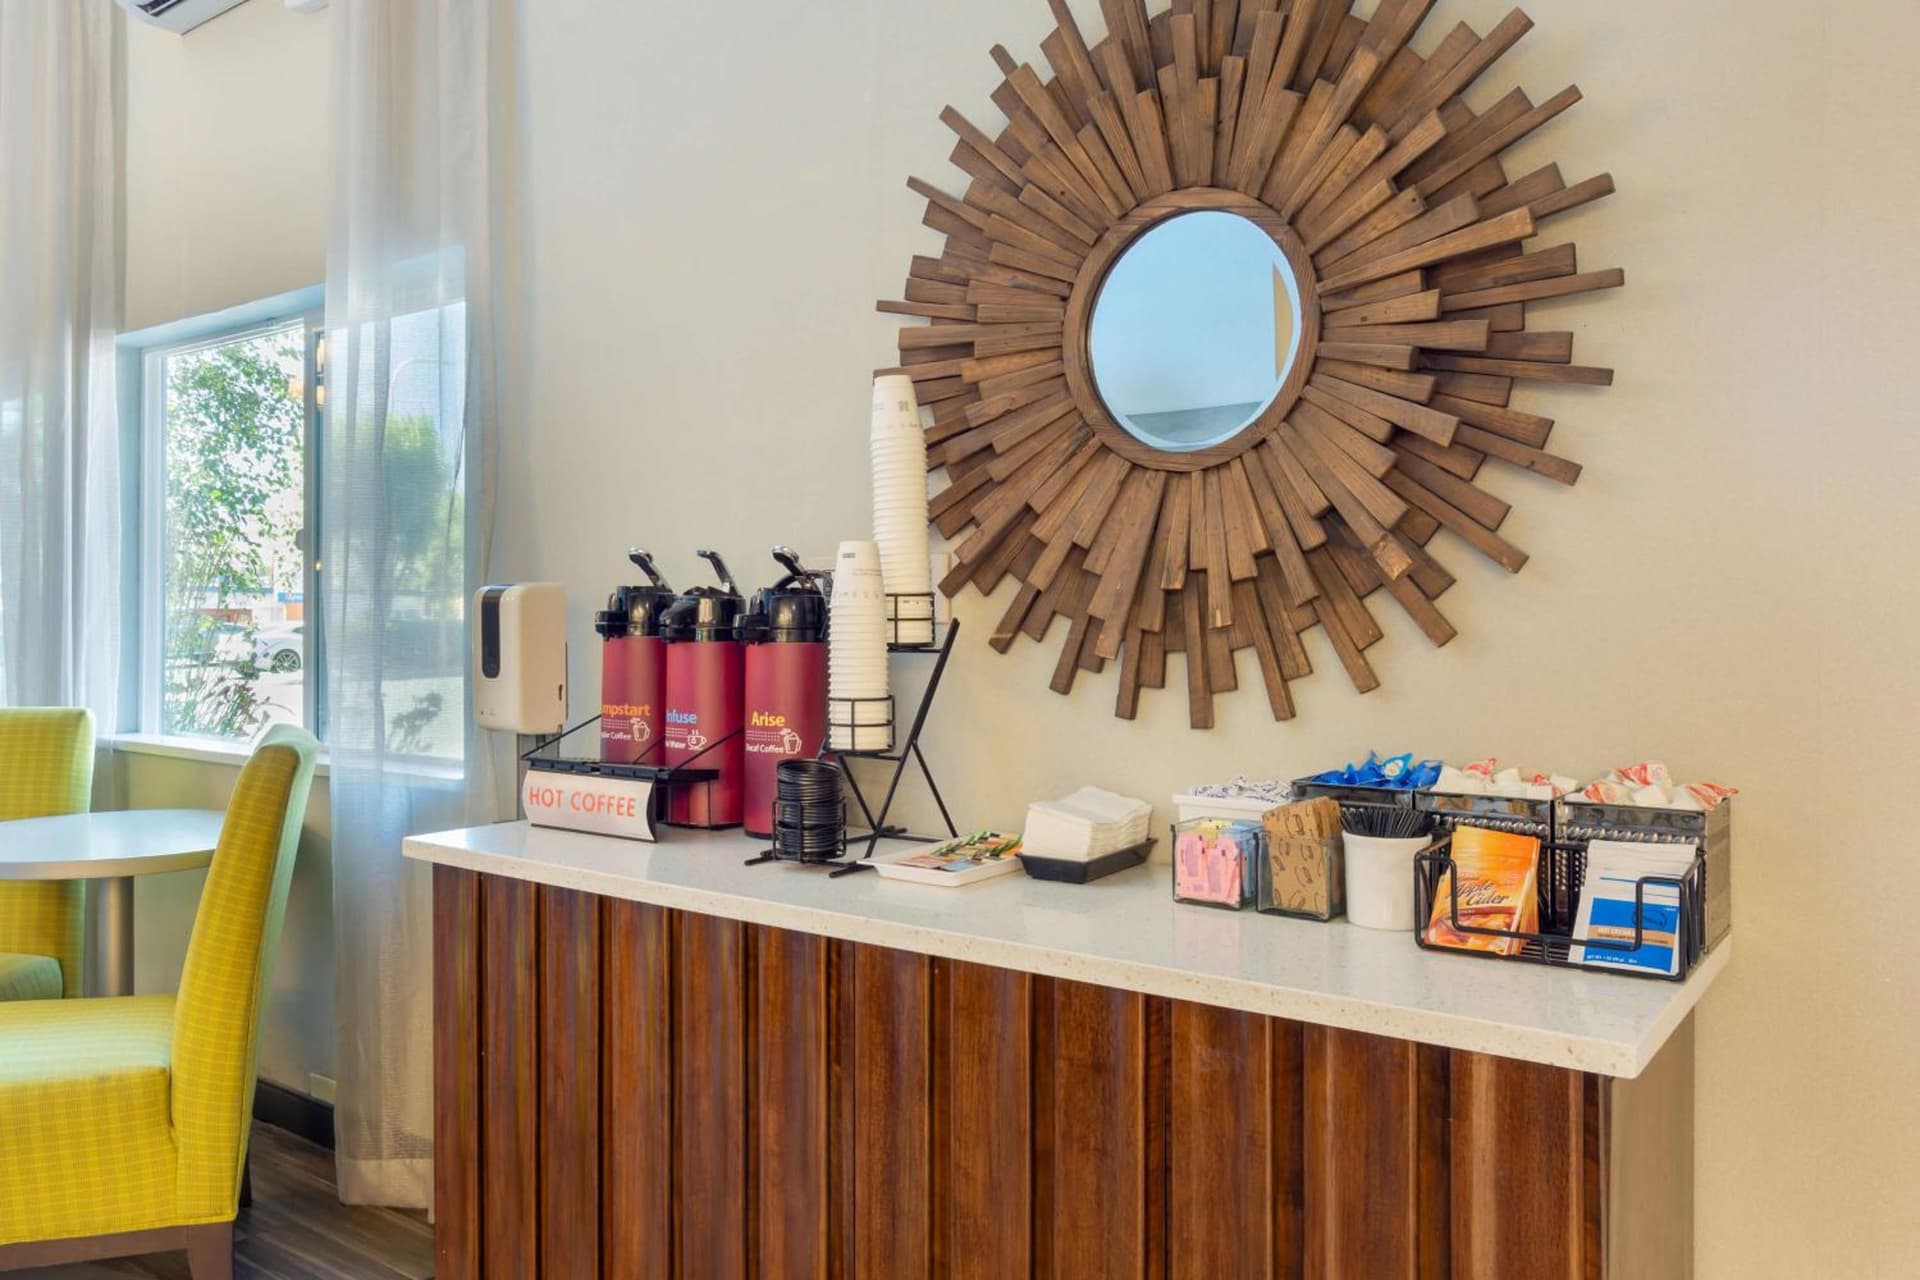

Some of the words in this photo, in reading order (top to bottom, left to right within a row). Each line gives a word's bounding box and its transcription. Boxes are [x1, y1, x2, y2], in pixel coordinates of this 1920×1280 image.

[602, 704, 651, 717] mpstart
[666, 709, 698, 724] nfuse
[751, 711, 785, 727] Arise
[760, 744, 785, 754] Coffee
[529, 785, 564, 808] HOT
[570, 791, 636, 817] COFFEE
[1466, 890, 1510, 906] Cider
